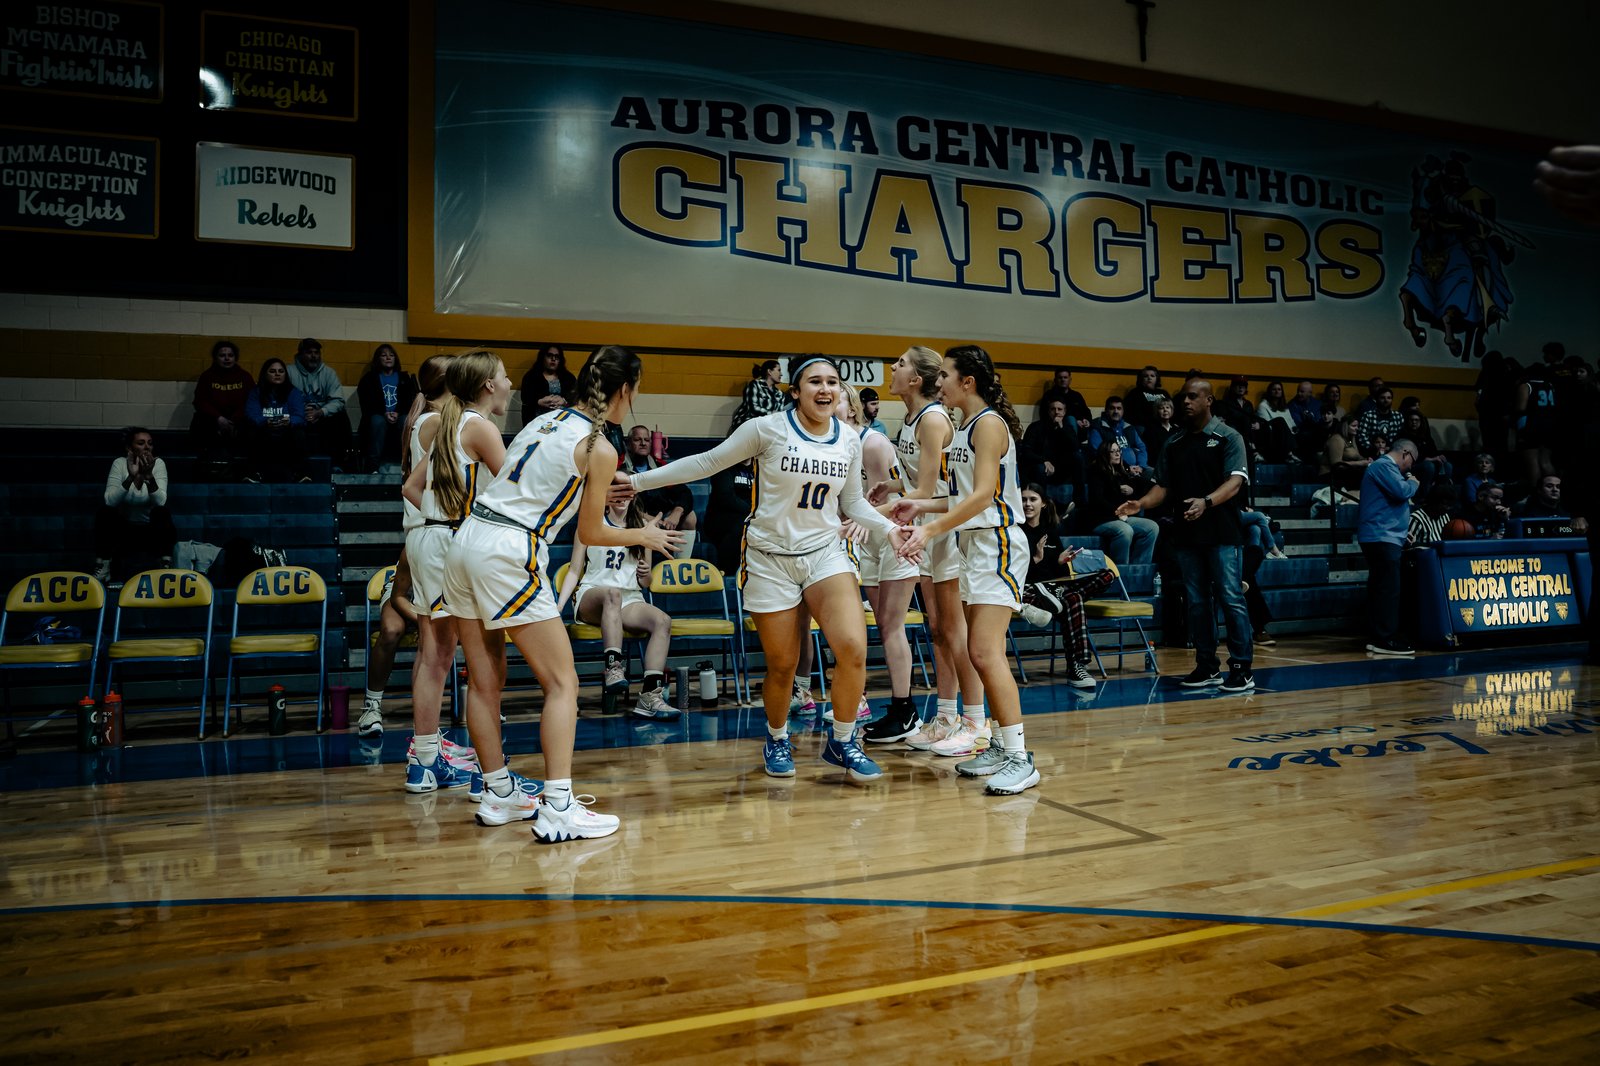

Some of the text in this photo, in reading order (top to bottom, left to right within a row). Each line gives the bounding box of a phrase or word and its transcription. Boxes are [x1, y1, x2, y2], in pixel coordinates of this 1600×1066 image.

[35, 4, 121, 33] BISHOP
[239, 31, 322, 56] CHICAGO
[97, 60, 153, 90] Irish
[225, 50, 335, 78] CHRISTIAN
[232, 72, 328, 109] Knights
[0, 144, 148, 176] IMMACULATE
[611, 97, 1384, 215] AURORA CENTRAL CATHOLIC
[2, 168, 138, 196] CONCEPTION
[216, 165, 336, 195] RIDGEWOOD
[17, 189, 126, 227] Knights
[237, 198, 317, 230] Rebels
[612, 141, 1386, 304] CHARGERS
[509, 441, 541, 481] 1
[780, 456, 848, 479] CHARGERS
[797, 482, 830, 510] 10
[661, 562, 711, 585] ACC
[1471, 560, 1525, 575] WELCOME
[23, 577, 89, 603] ACC
[134, 573, 198, 599] ACC
[251, 570, 311, 596] ACC
[1449, 574, 1572, 601] AURORA CENTRAL
[1482, 601, 1550, 626] CATHOLIC
[1232, 725, 1377, 744] Coach
